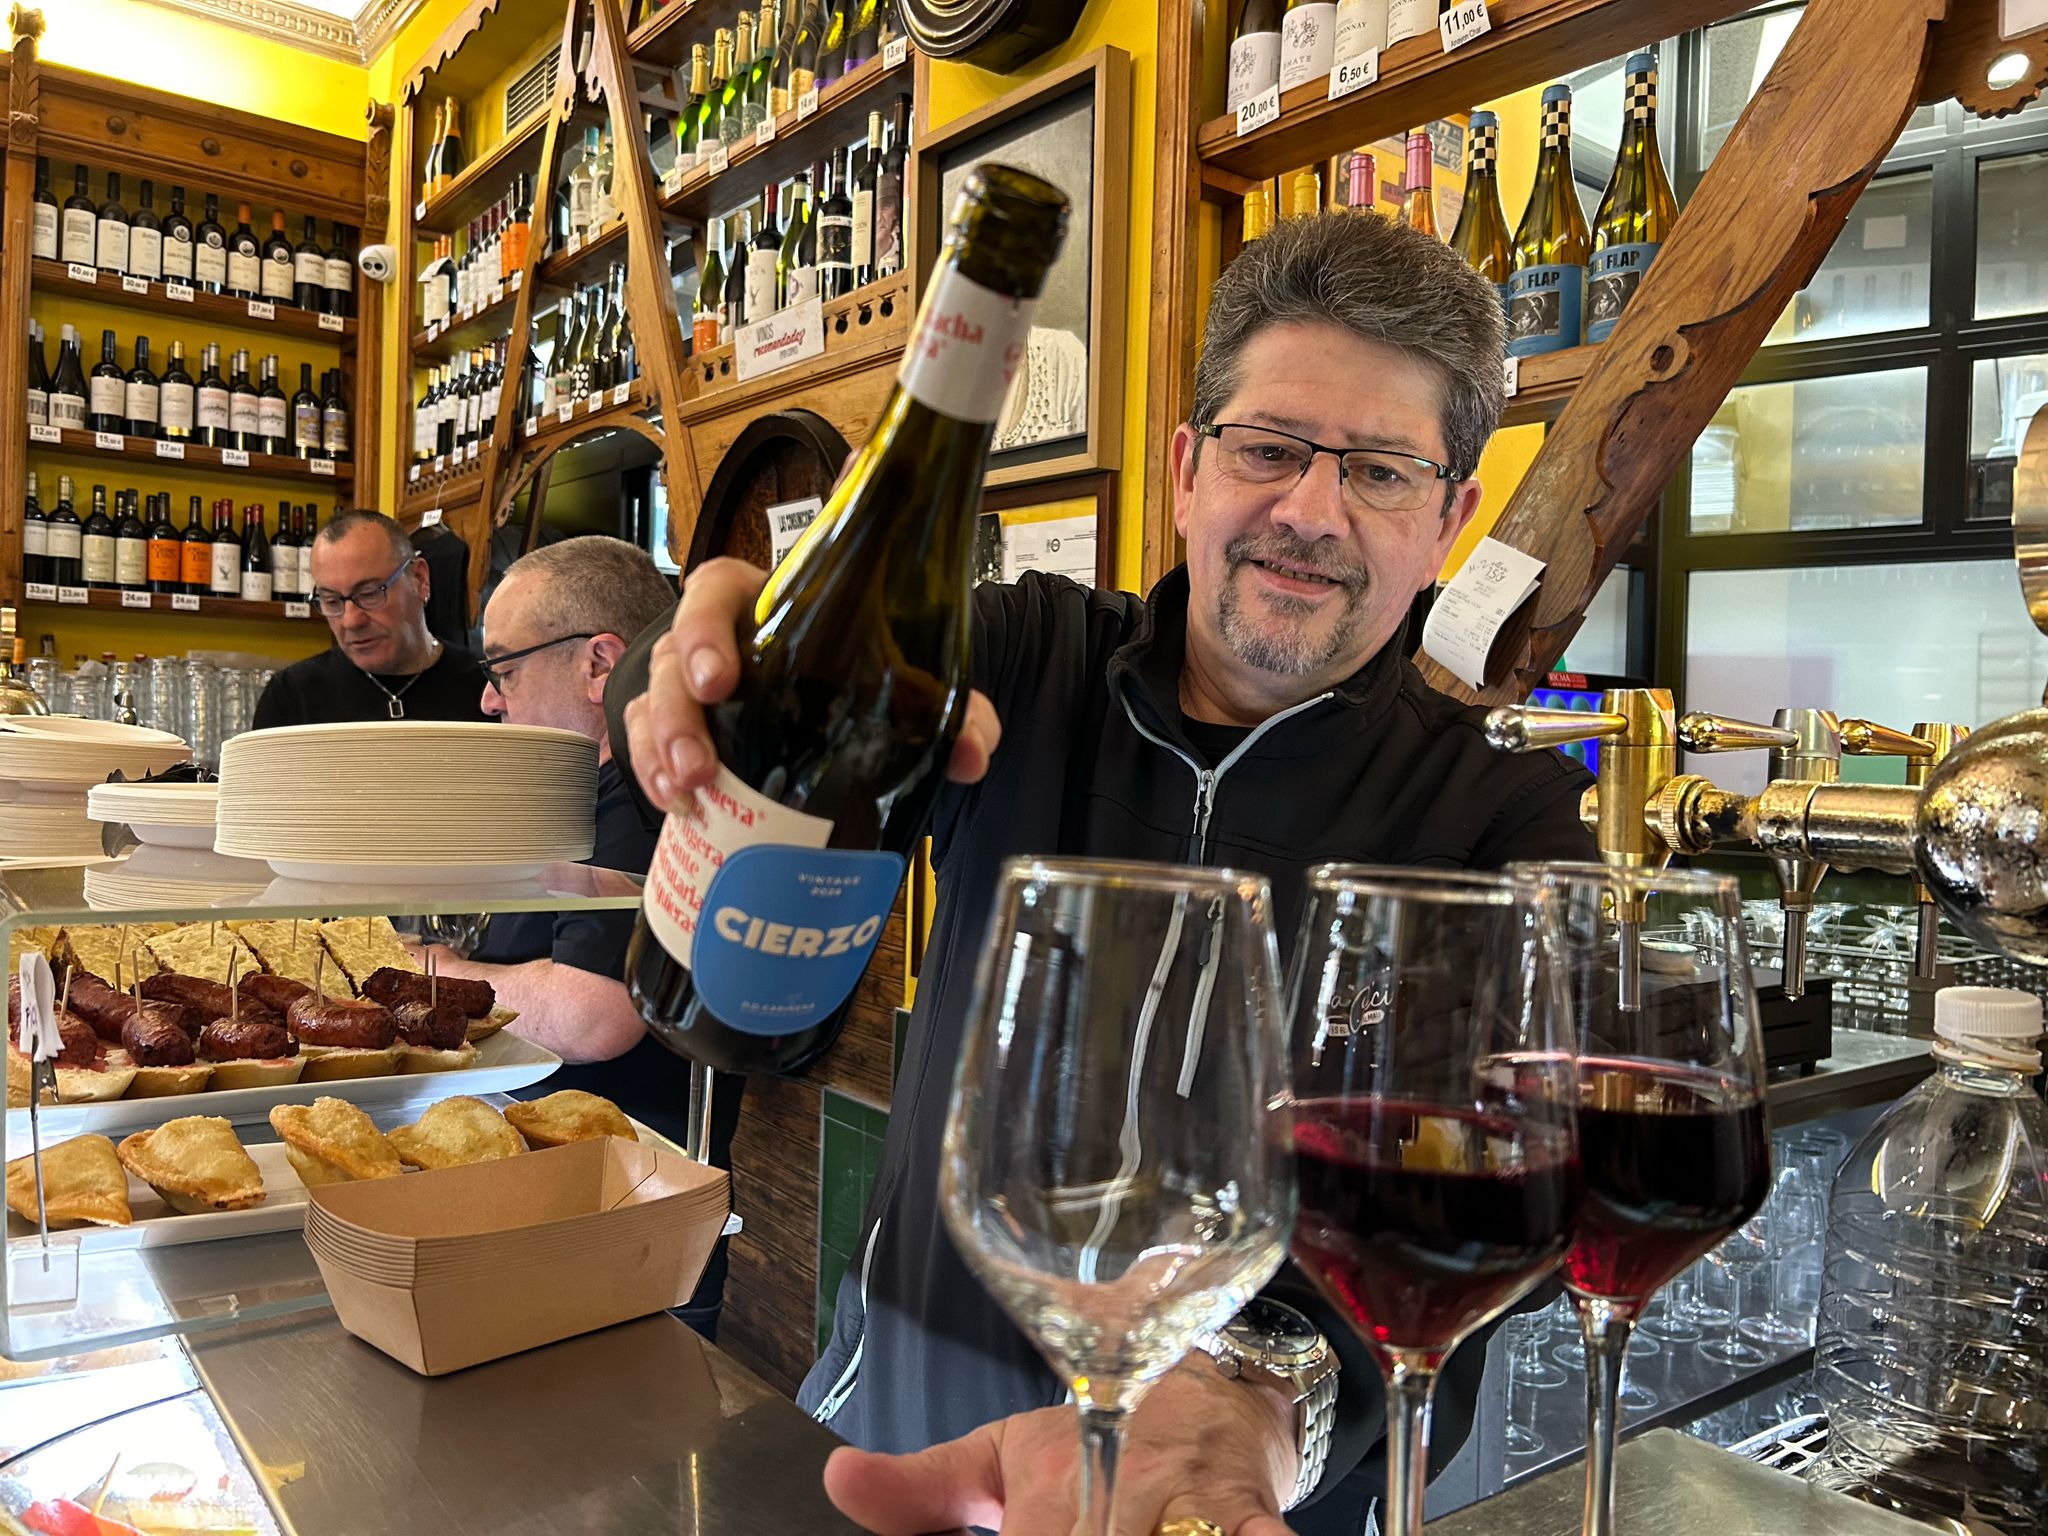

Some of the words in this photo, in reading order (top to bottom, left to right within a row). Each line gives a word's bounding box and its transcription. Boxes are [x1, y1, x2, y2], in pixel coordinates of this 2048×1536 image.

[1444, 9, 1475, 34] 11,00
[1477, 4, 1484, 18] €
[1339, 66, 1361, 84] 6,50
[1363, 62, 1369, 74] €
[1241, 101, 1268, 122] 20,00
[1269, 96, 1275, 108] €
[1607, 250, 1640, 269] FLAP
[1528, 271, 1560, 288] FLAP
[714, 905, 882, 959] CIERZO
